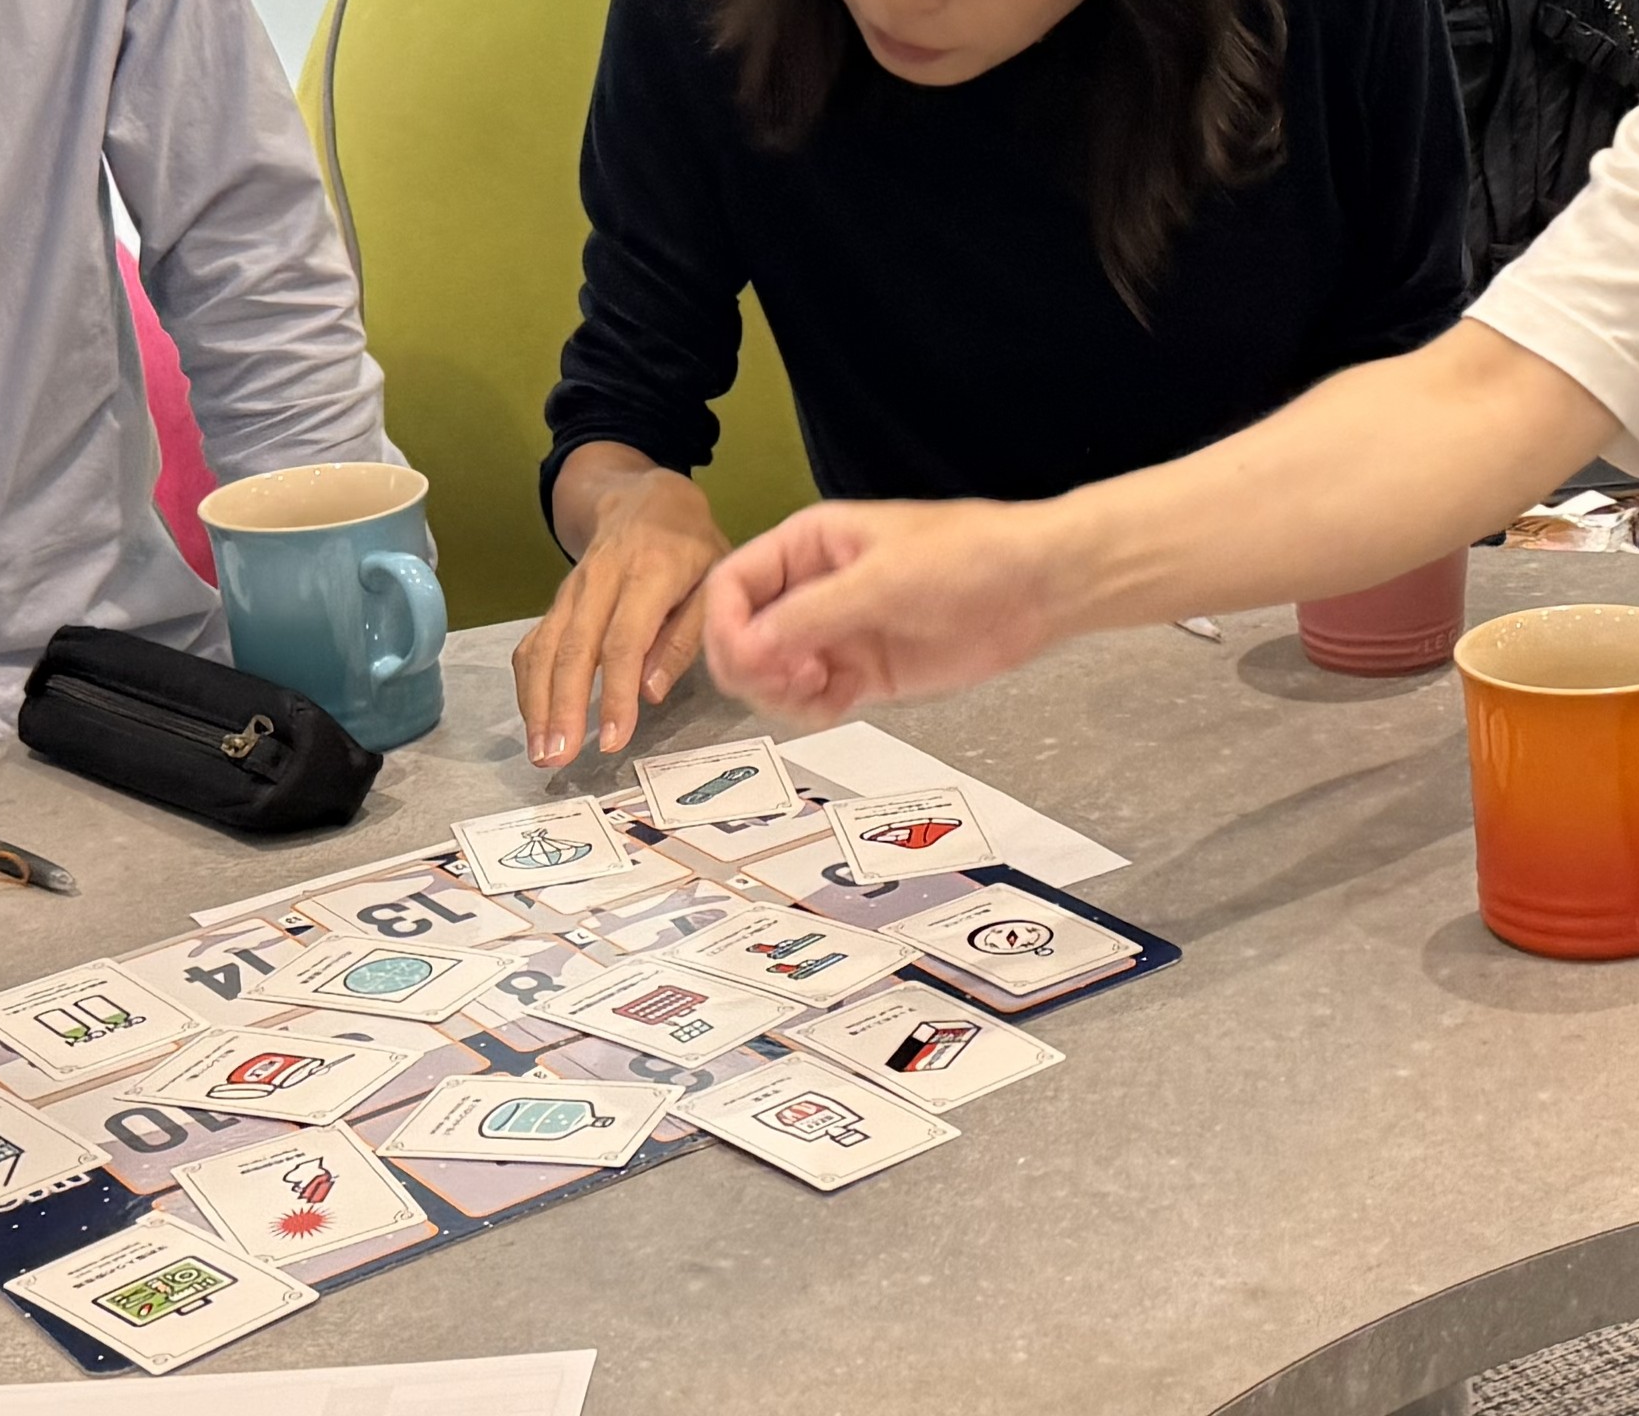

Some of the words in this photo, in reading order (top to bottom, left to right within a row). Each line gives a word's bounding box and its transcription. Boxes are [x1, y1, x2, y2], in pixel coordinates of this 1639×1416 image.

[357, 891, 478, 939] 13
[183, 949, 276, 1001] 14
[104, 1106, 241, 1155] 10
